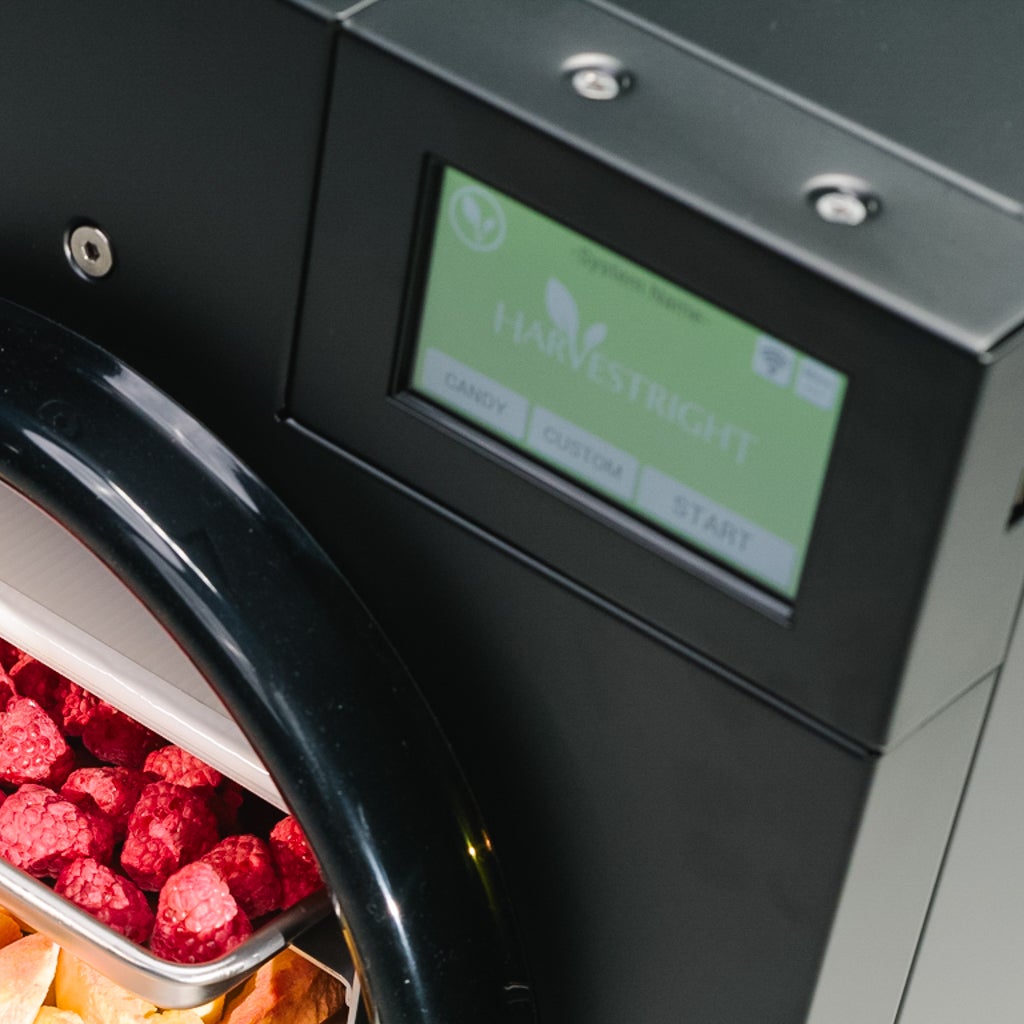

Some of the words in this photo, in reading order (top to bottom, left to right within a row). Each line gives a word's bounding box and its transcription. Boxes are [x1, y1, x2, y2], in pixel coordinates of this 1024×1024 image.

[444, 369, 508, 416] CANDY
[492, 278, 758, 466] HARVESTRIGHT
[541, 424, 625, 482] CUSTOM
[672, 492, 753, 554] START
